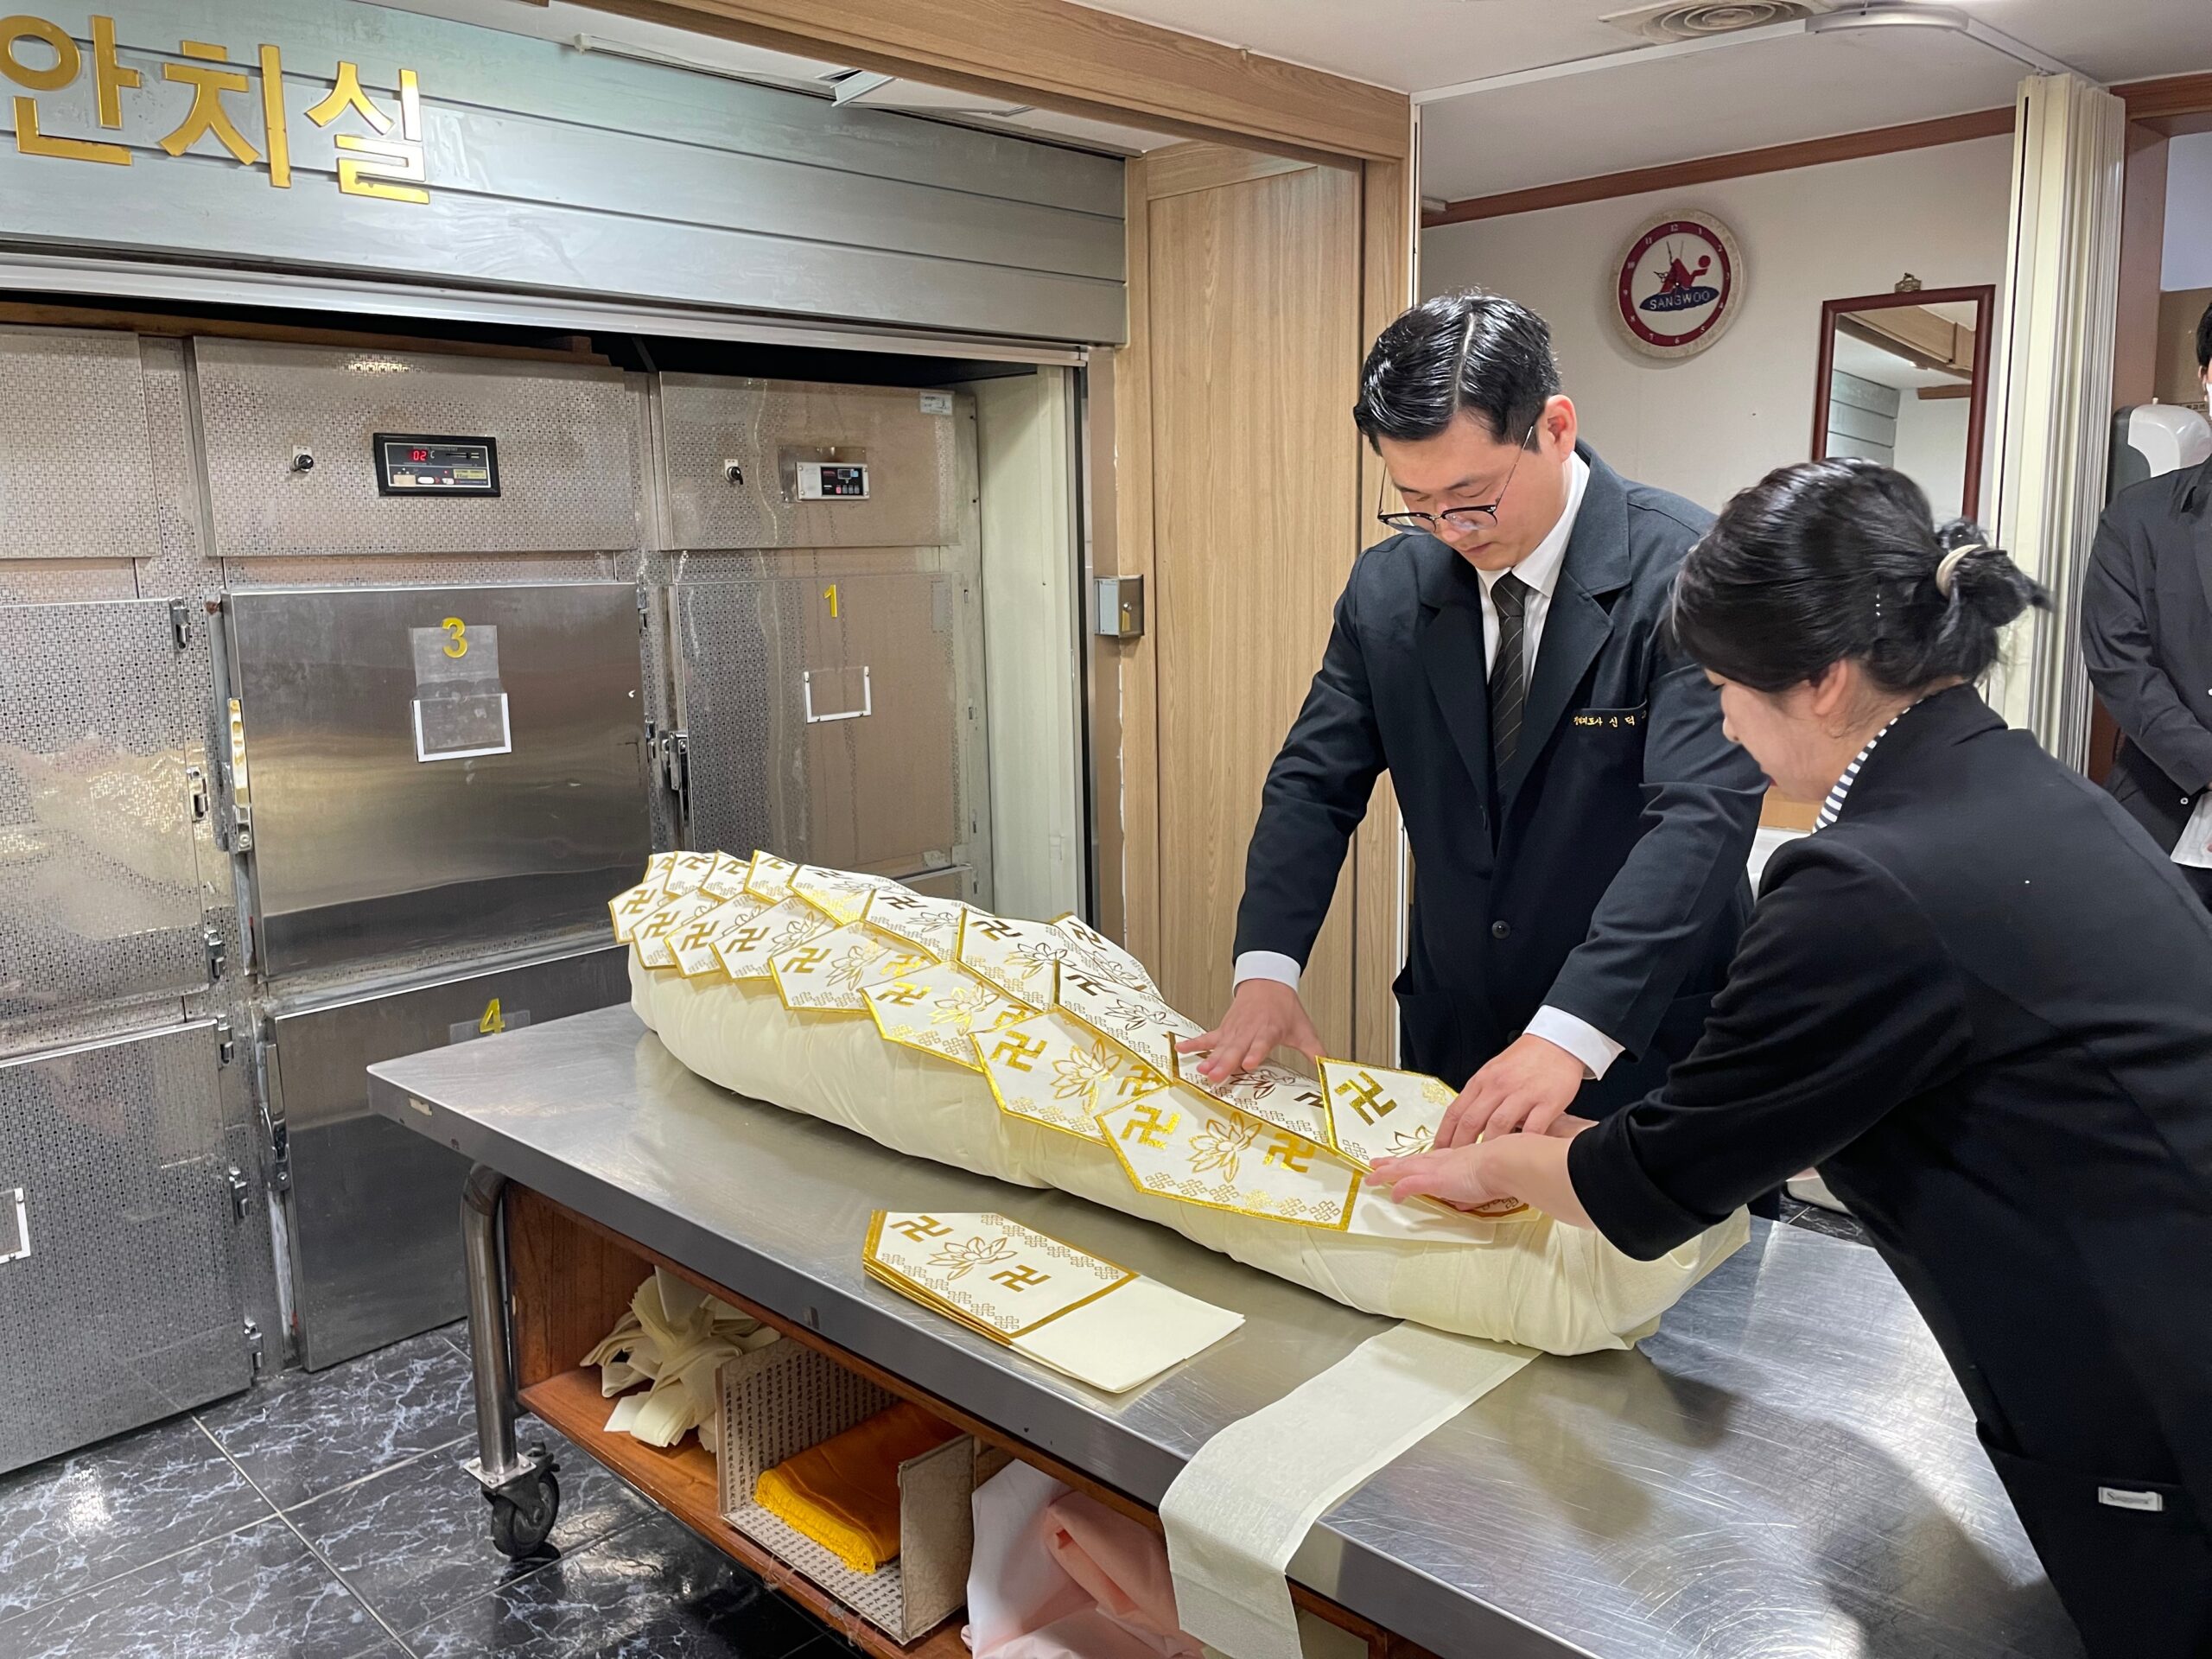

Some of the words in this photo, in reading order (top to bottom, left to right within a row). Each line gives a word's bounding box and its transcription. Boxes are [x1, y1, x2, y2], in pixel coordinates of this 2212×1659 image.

[0, 15, 429, 204] 안치실
[1649, 290, 1711, 310] SANGWOO
[413, 450, 427, 461] 02
[823, 584, 837, 618] 1
[442, 617, 468, 658] 3
[480, 997, 505, 1034] 4
